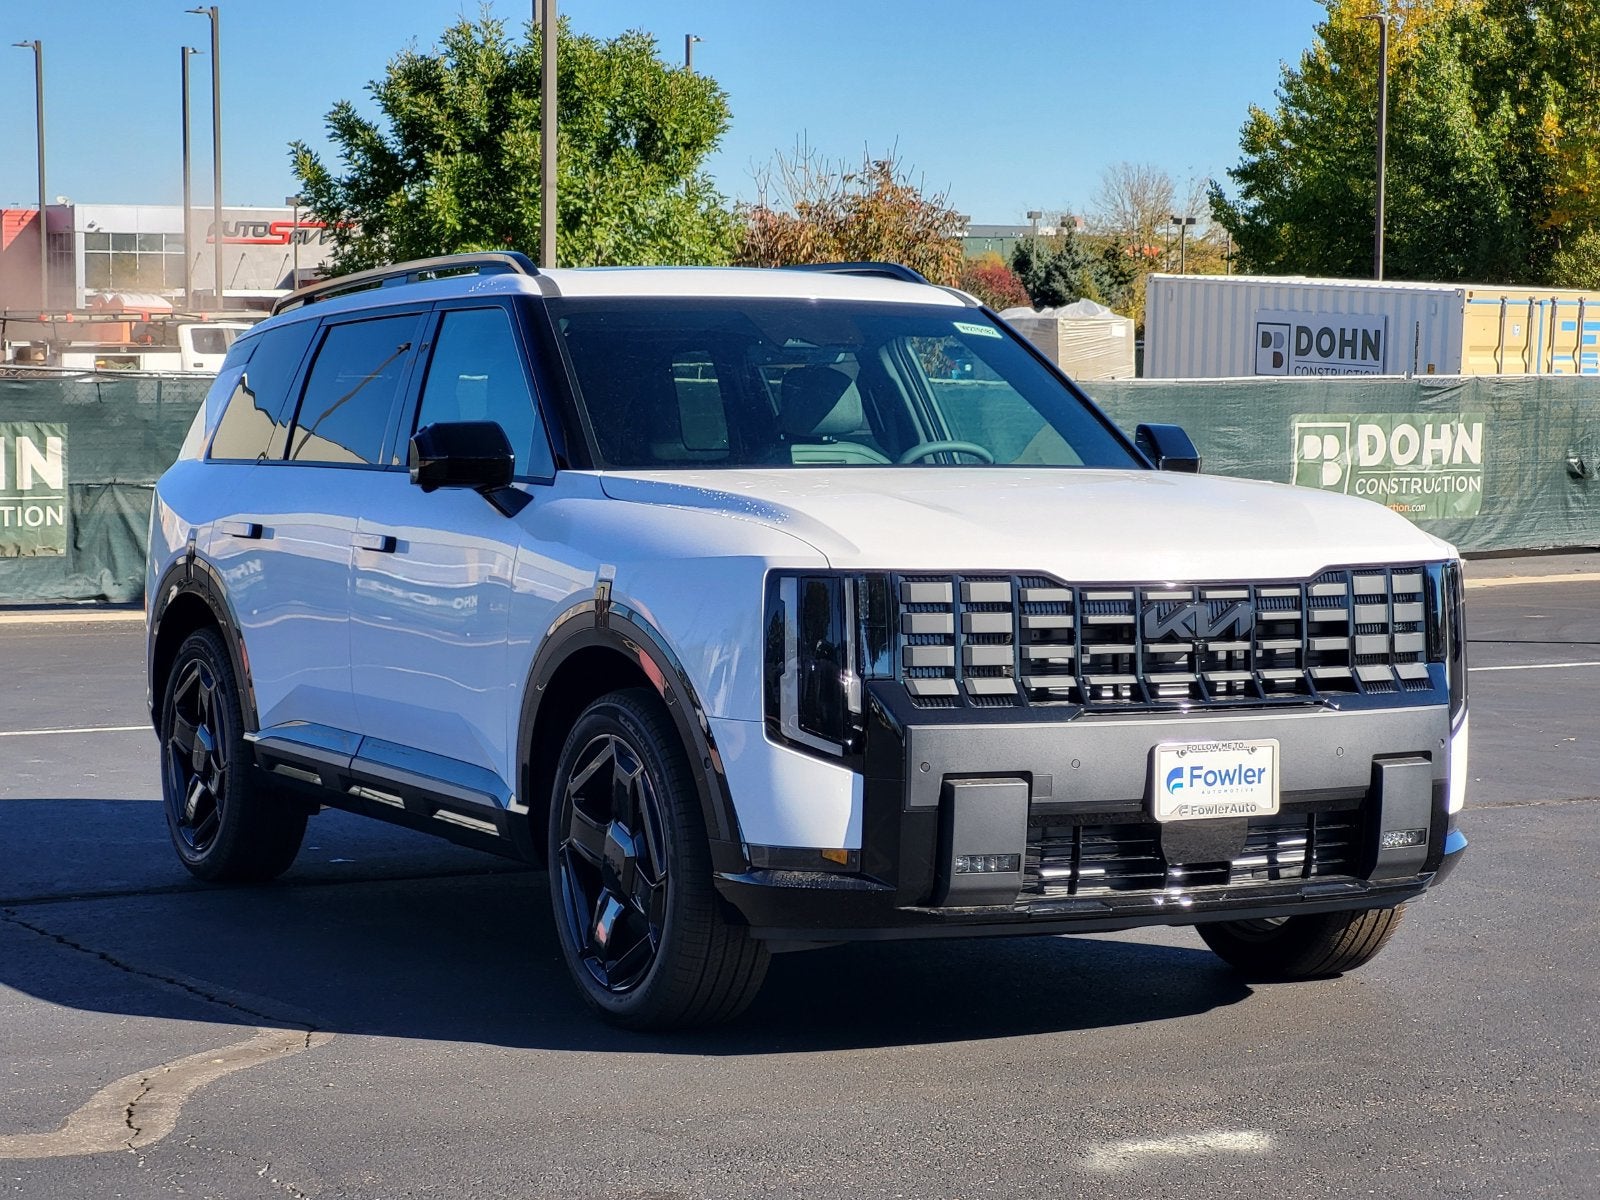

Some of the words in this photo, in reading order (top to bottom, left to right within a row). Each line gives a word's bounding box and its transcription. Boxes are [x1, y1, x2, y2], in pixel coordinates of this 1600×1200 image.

[1295, 325, 1381, 361] DOHN
[1358, 422, 1483, 467] DOHN
[1355, 475, 1482, 495] CONSTRUCTION
[1186, 743, 1220, 751] FOLLOW
[1221, 742, 1232, 750] ME
[1189, 764, 1266, 788] Fowler
[1190, 803, 1258, 816] FowlerAuto
